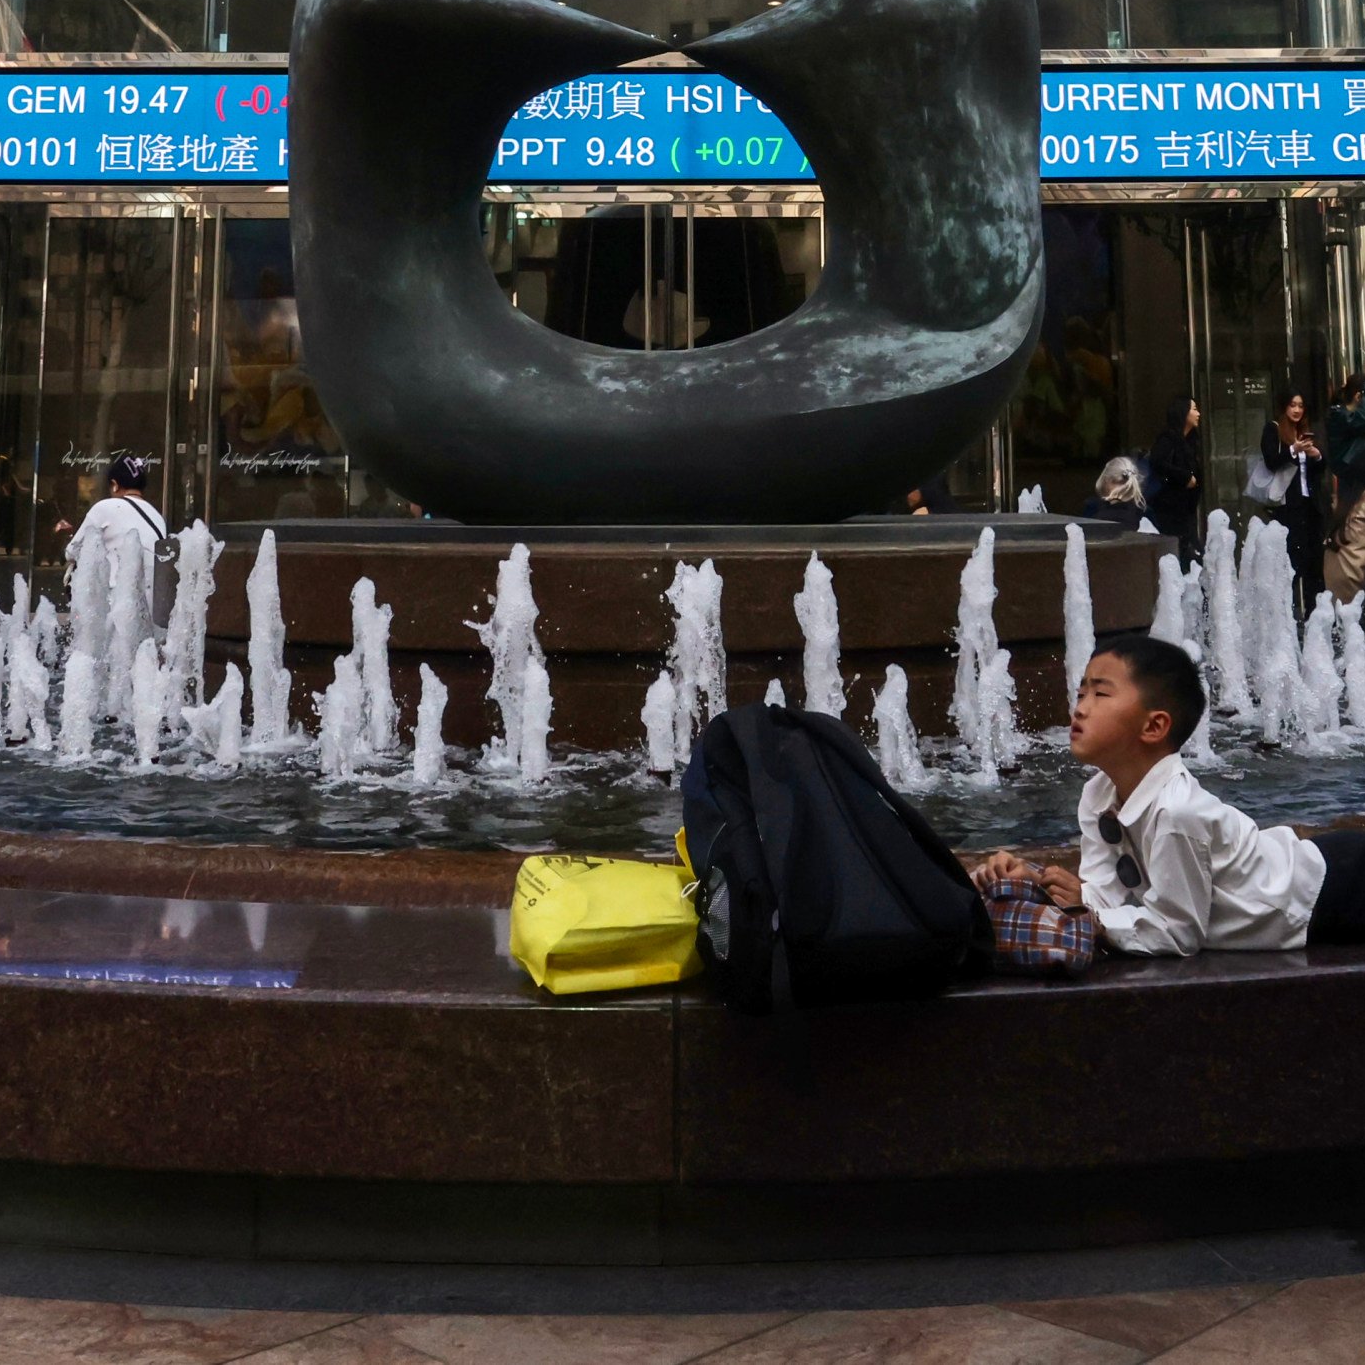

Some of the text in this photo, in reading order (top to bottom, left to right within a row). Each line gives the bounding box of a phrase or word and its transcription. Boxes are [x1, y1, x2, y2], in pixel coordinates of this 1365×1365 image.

[8, 85, 85, 113] GEM
[104, 86, 188, 114] 19.47
[511, 81, 722, 120] 數期貨 HSI
[1042, 84, 1185, 111] URRENT
[1196, 82, 1320, 110] MONTH
[96, 134, 258, 172] 恒隆地產
[498, 137, 783, 165] PPT 9.48 +0.07
[1042, 135, 1139, 164] 00175
[1155, 130, 1315, 169] 吉利汽車
